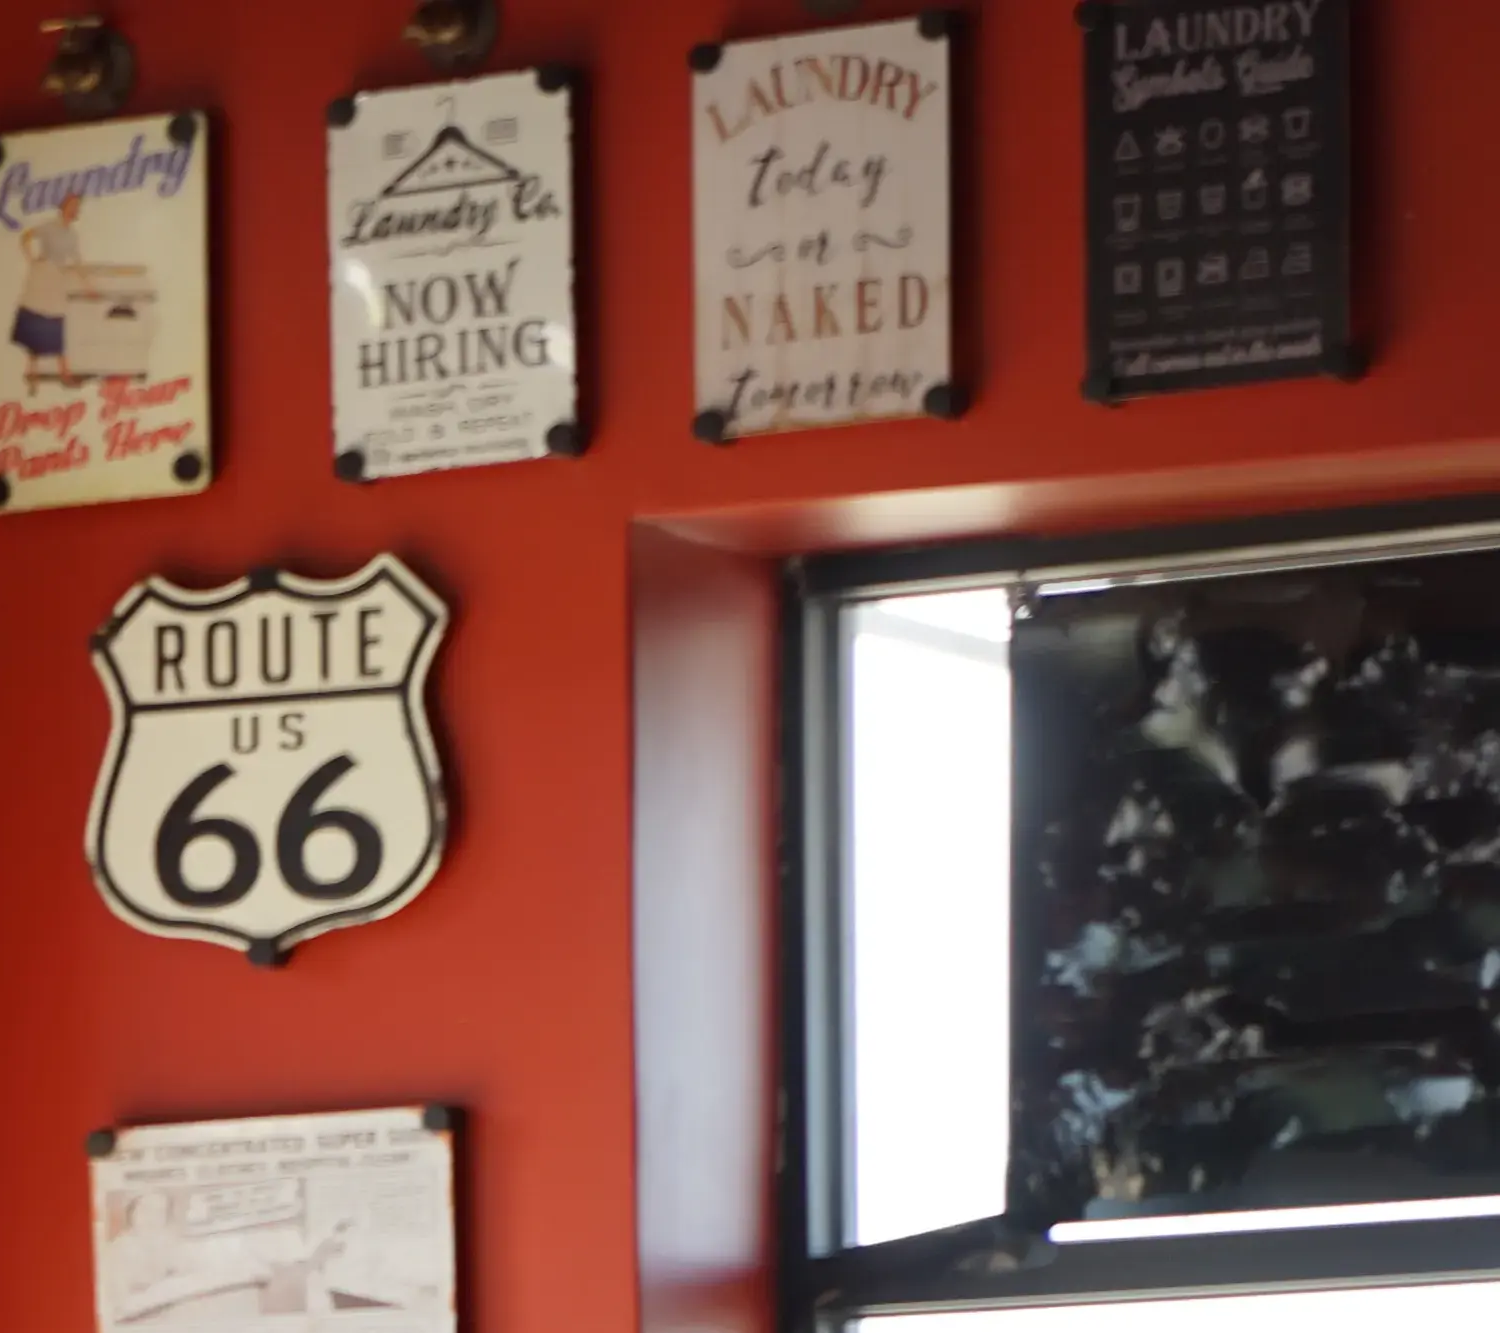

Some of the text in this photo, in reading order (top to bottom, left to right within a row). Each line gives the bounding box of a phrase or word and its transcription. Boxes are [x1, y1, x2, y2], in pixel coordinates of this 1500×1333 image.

[1113, 2, 1318, 61] LAUNDRY
[706, 54, 939, 144] LAUNDRY
[340, 191, 499, 247] Laundry
[382, 257, 520, 330] NOW
[720, 272, 930, 351] NAKED
[358, 320, 548, 390] HIRING
[99, 376, 192, 420] Your
[150, 606, 385, 698] ROUTE
[230, 710, 306, 755] US
[154, 752, 385, 908] 66
